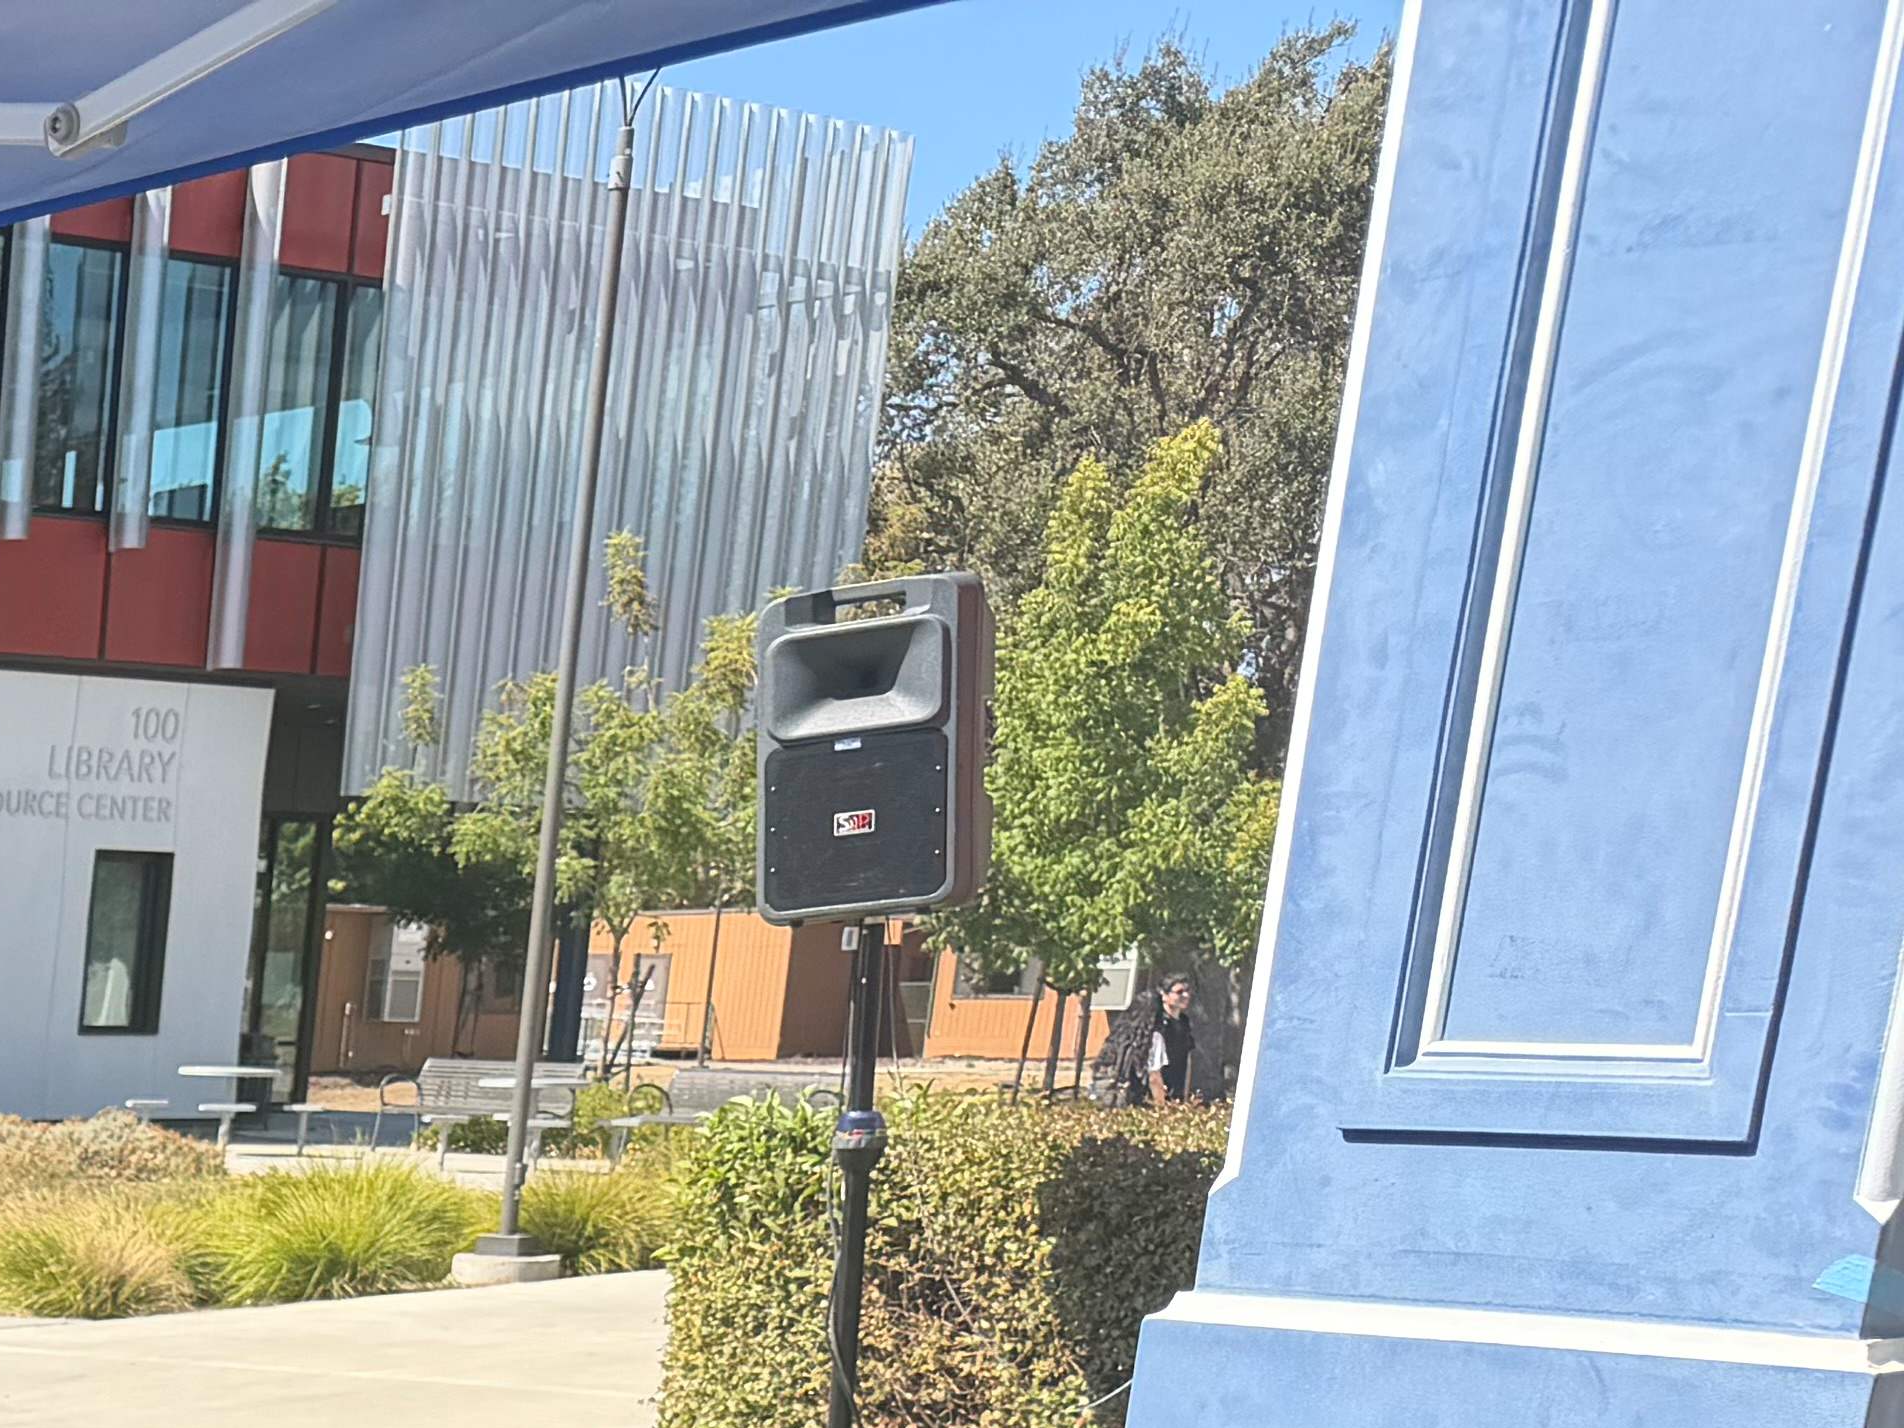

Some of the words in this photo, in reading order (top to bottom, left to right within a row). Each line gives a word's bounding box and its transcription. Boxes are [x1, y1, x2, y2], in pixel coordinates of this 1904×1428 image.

[131, 707, 180, 742] 100
[47, 745, 177, 784] LIBRARY
[77, 792, 173, 824] CENTER
